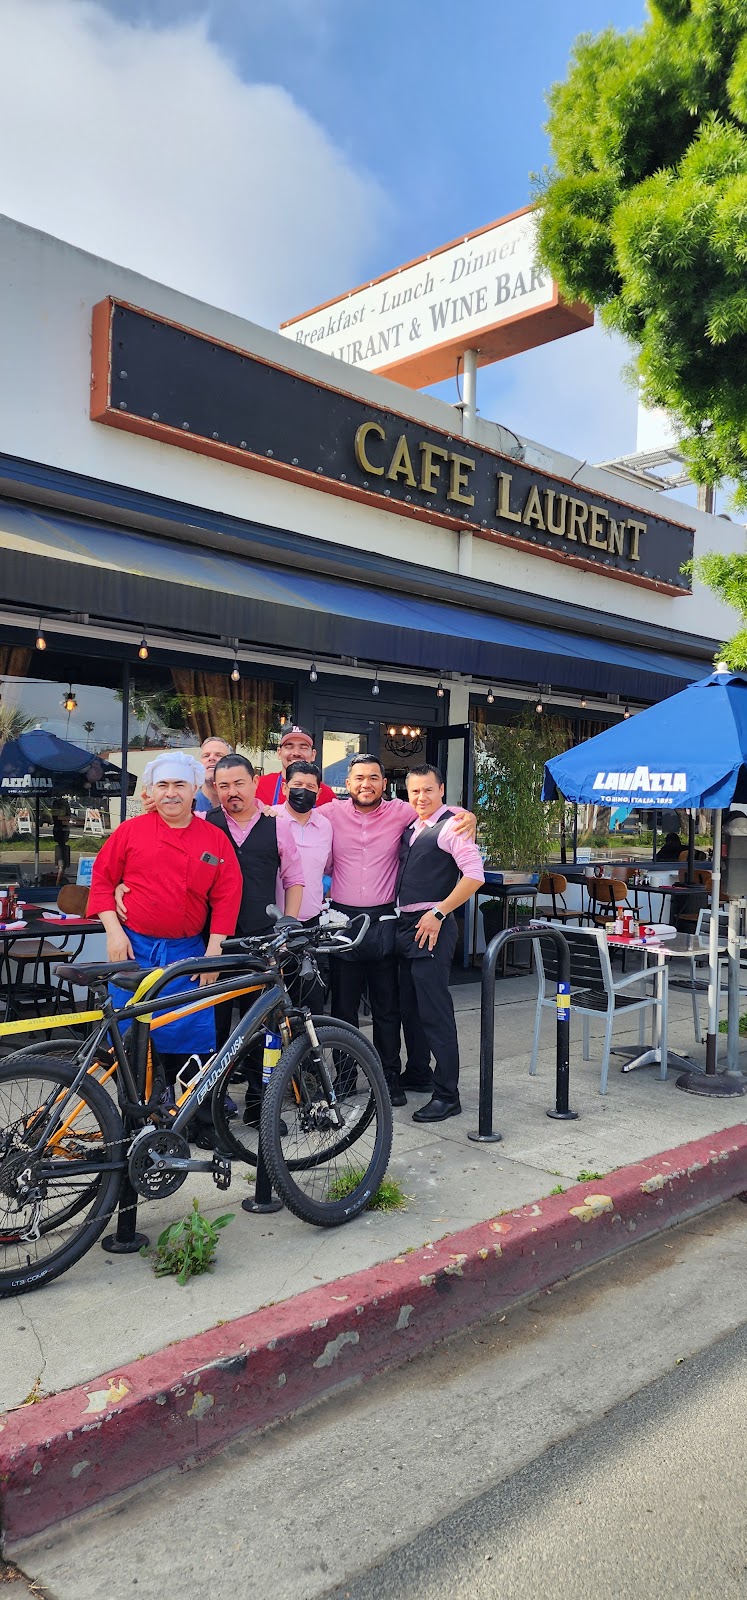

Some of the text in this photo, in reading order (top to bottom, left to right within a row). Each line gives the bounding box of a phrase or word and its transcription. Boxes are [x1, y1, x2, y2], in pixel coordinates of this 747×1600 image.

[295, 303, 366, 346] Breakfast
[379, 271, 434, 314] Lunch
[449, 238, 520, 284] Dinner
[408, 317, 422, 341] &
[429, 286, 488, 332] WINE
[494, 266, 546, 307] BAR
[354, 421, 648, 561] CAFE LAURENT
[592, 766, 687, 791] LAVAZZA
[558, 983, 566, 994] P
[265, 1034, 273, 1047] P
